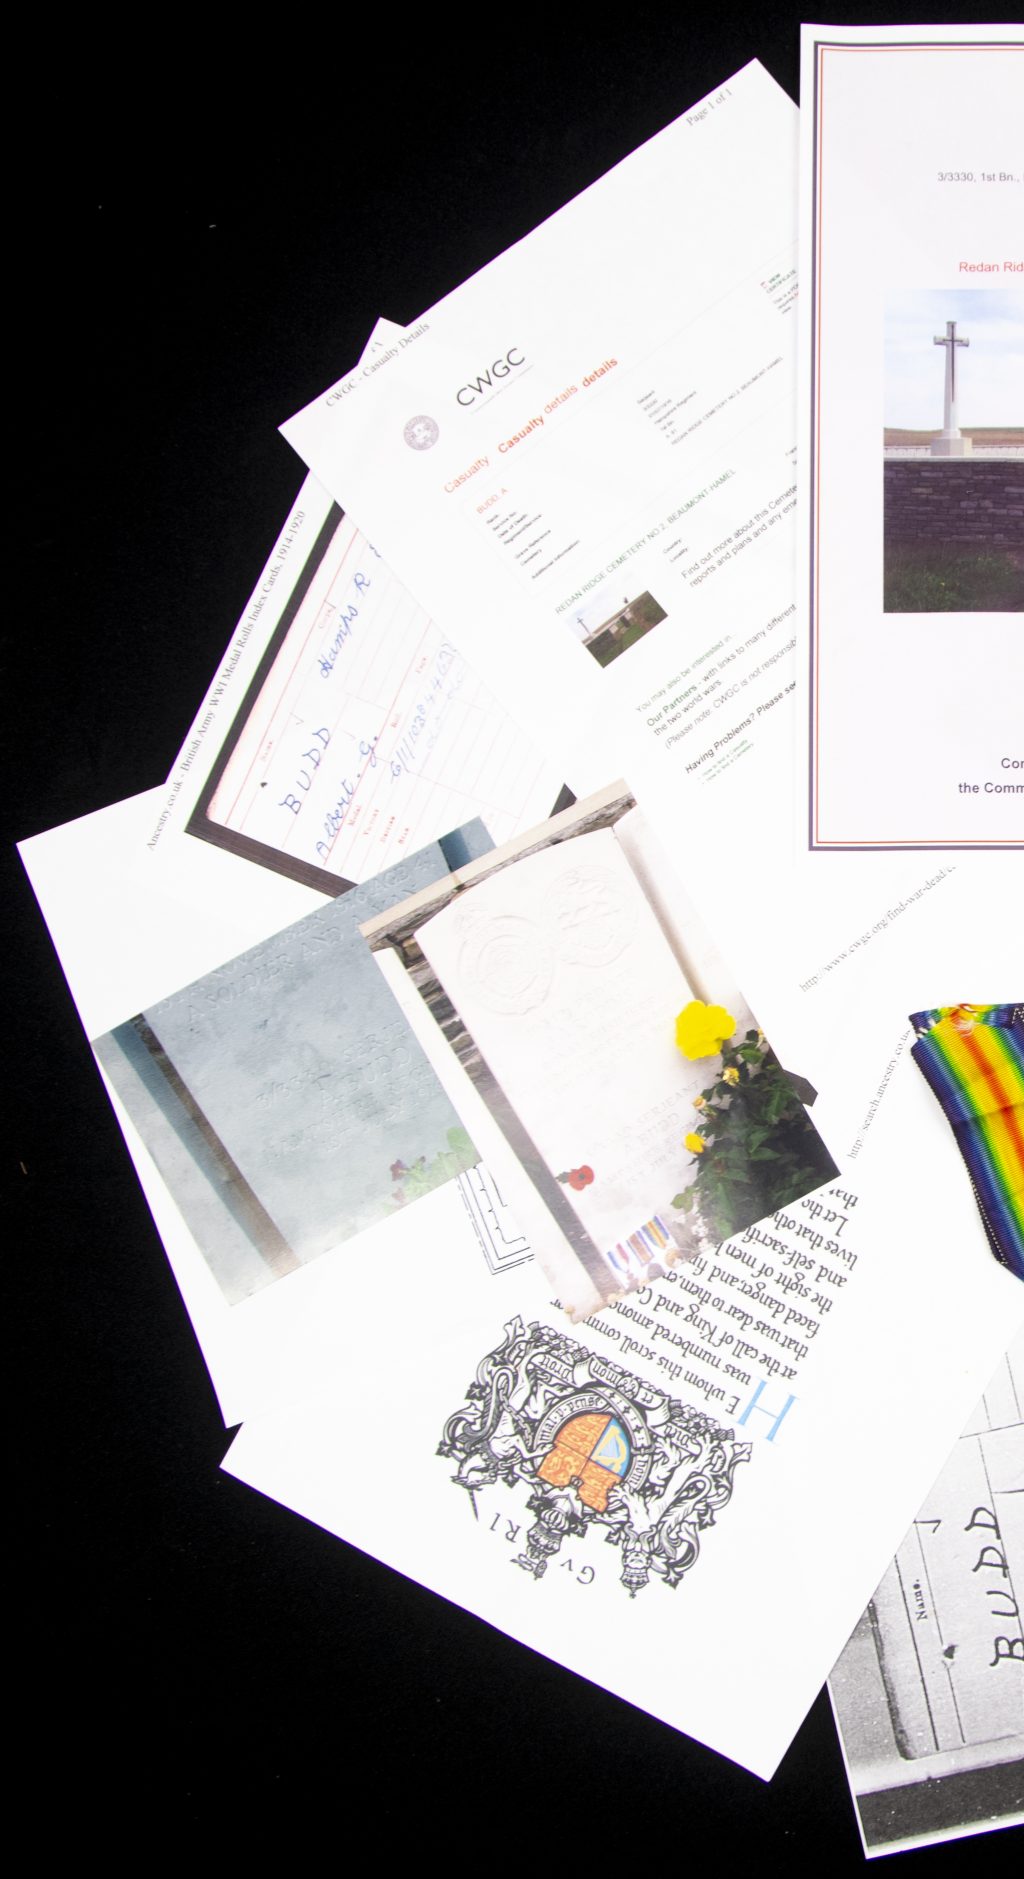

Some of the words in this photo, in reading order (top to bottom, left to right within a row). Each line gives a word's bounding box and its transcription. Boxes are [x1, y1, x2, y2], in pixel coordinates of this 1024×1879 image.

[686, 107, 709, 127] Page
[715, 92, 726, 104] of
[938, 172, 976, 182] 3/3330,
[982, 173, 995, 182] 1st
[999, 172, 1019, 182] Bn.,
[960, 262, 999, 272] Redan
[325, 378, 356, 407] CWGC
[361, 348, 399, 377] Casualty
[398, 322, 430, 349] Details
[454, 346, 526, 408] CWGC
[443, 455, 490, 494] Casualty
[497, 414, 545, 454] Casualty
[542, 384, 579, 415] details
[581, 357, 619, 388] details
[146, 780, 184, 850] Ancestry.co.uk
[179, 739, 202, 772] British
[196, 710, 216, 738] Army
[209, 681, 228, 707] WWI
[221, 648, 243, 680] Medal
[236, 623, 254, 648] Rolls
[247, 595, 268, 622] Index
[261, 564, 283, 593] Cards,
[276, 510, 305, 561] 1914-1920
[646, 711, 663, 727] Our
[661, 684, 697, 714] Partners
[701, 667, 718, 682] with
[717, 653, 736, 669] links
[735, 645, 744, 654] to
[744, 629, 766, 648] many
[766, 603, 797, 631] different
[685, 748, 715, 774] Having
[713, 712, 755, 751] Problems?
[755, 692, 784, 716] Please
[277, 726, 332, 815] BUDD
[958, 782, 979, 793] the
[653, 1294, 684, 1318] and
[682, 1303, 718, 1342] King
[619, 1335, 657, 1362] scroll
[650, 1323, 722, 1370] numbered
[710, 1330, 735, 1349] of
[731, 1339, 759, 1361] call
[655, 1355, 683, 1381] this
[721, 1363, 752, 1386] was
[758, 1353, 781, 1377] the
[779, 1365, 797, 1381] at
[682, 1370, 726, 1402] whom
[911, 1579, 928, 1620] Name.
